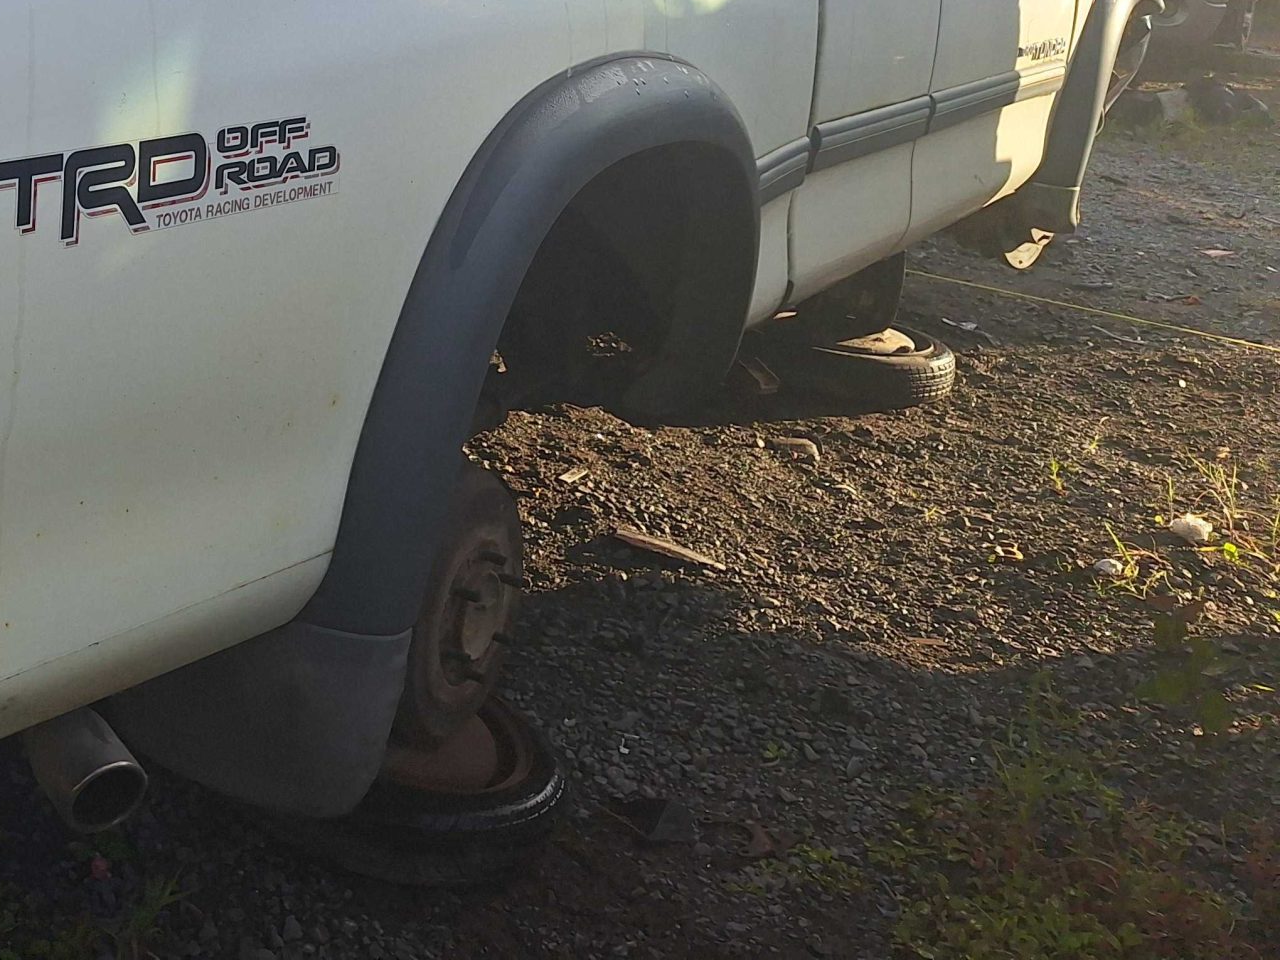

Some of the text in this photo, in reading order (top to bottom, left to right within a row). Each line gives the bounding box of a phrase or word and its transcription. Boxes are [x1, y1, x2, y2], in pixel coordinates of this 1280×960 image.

[216, 116, 311, 158] OFF
[214, 145, 341, 195] ROAD
[156, 181, 334, 228] TOYOTA RACING DEVELOPMENT
